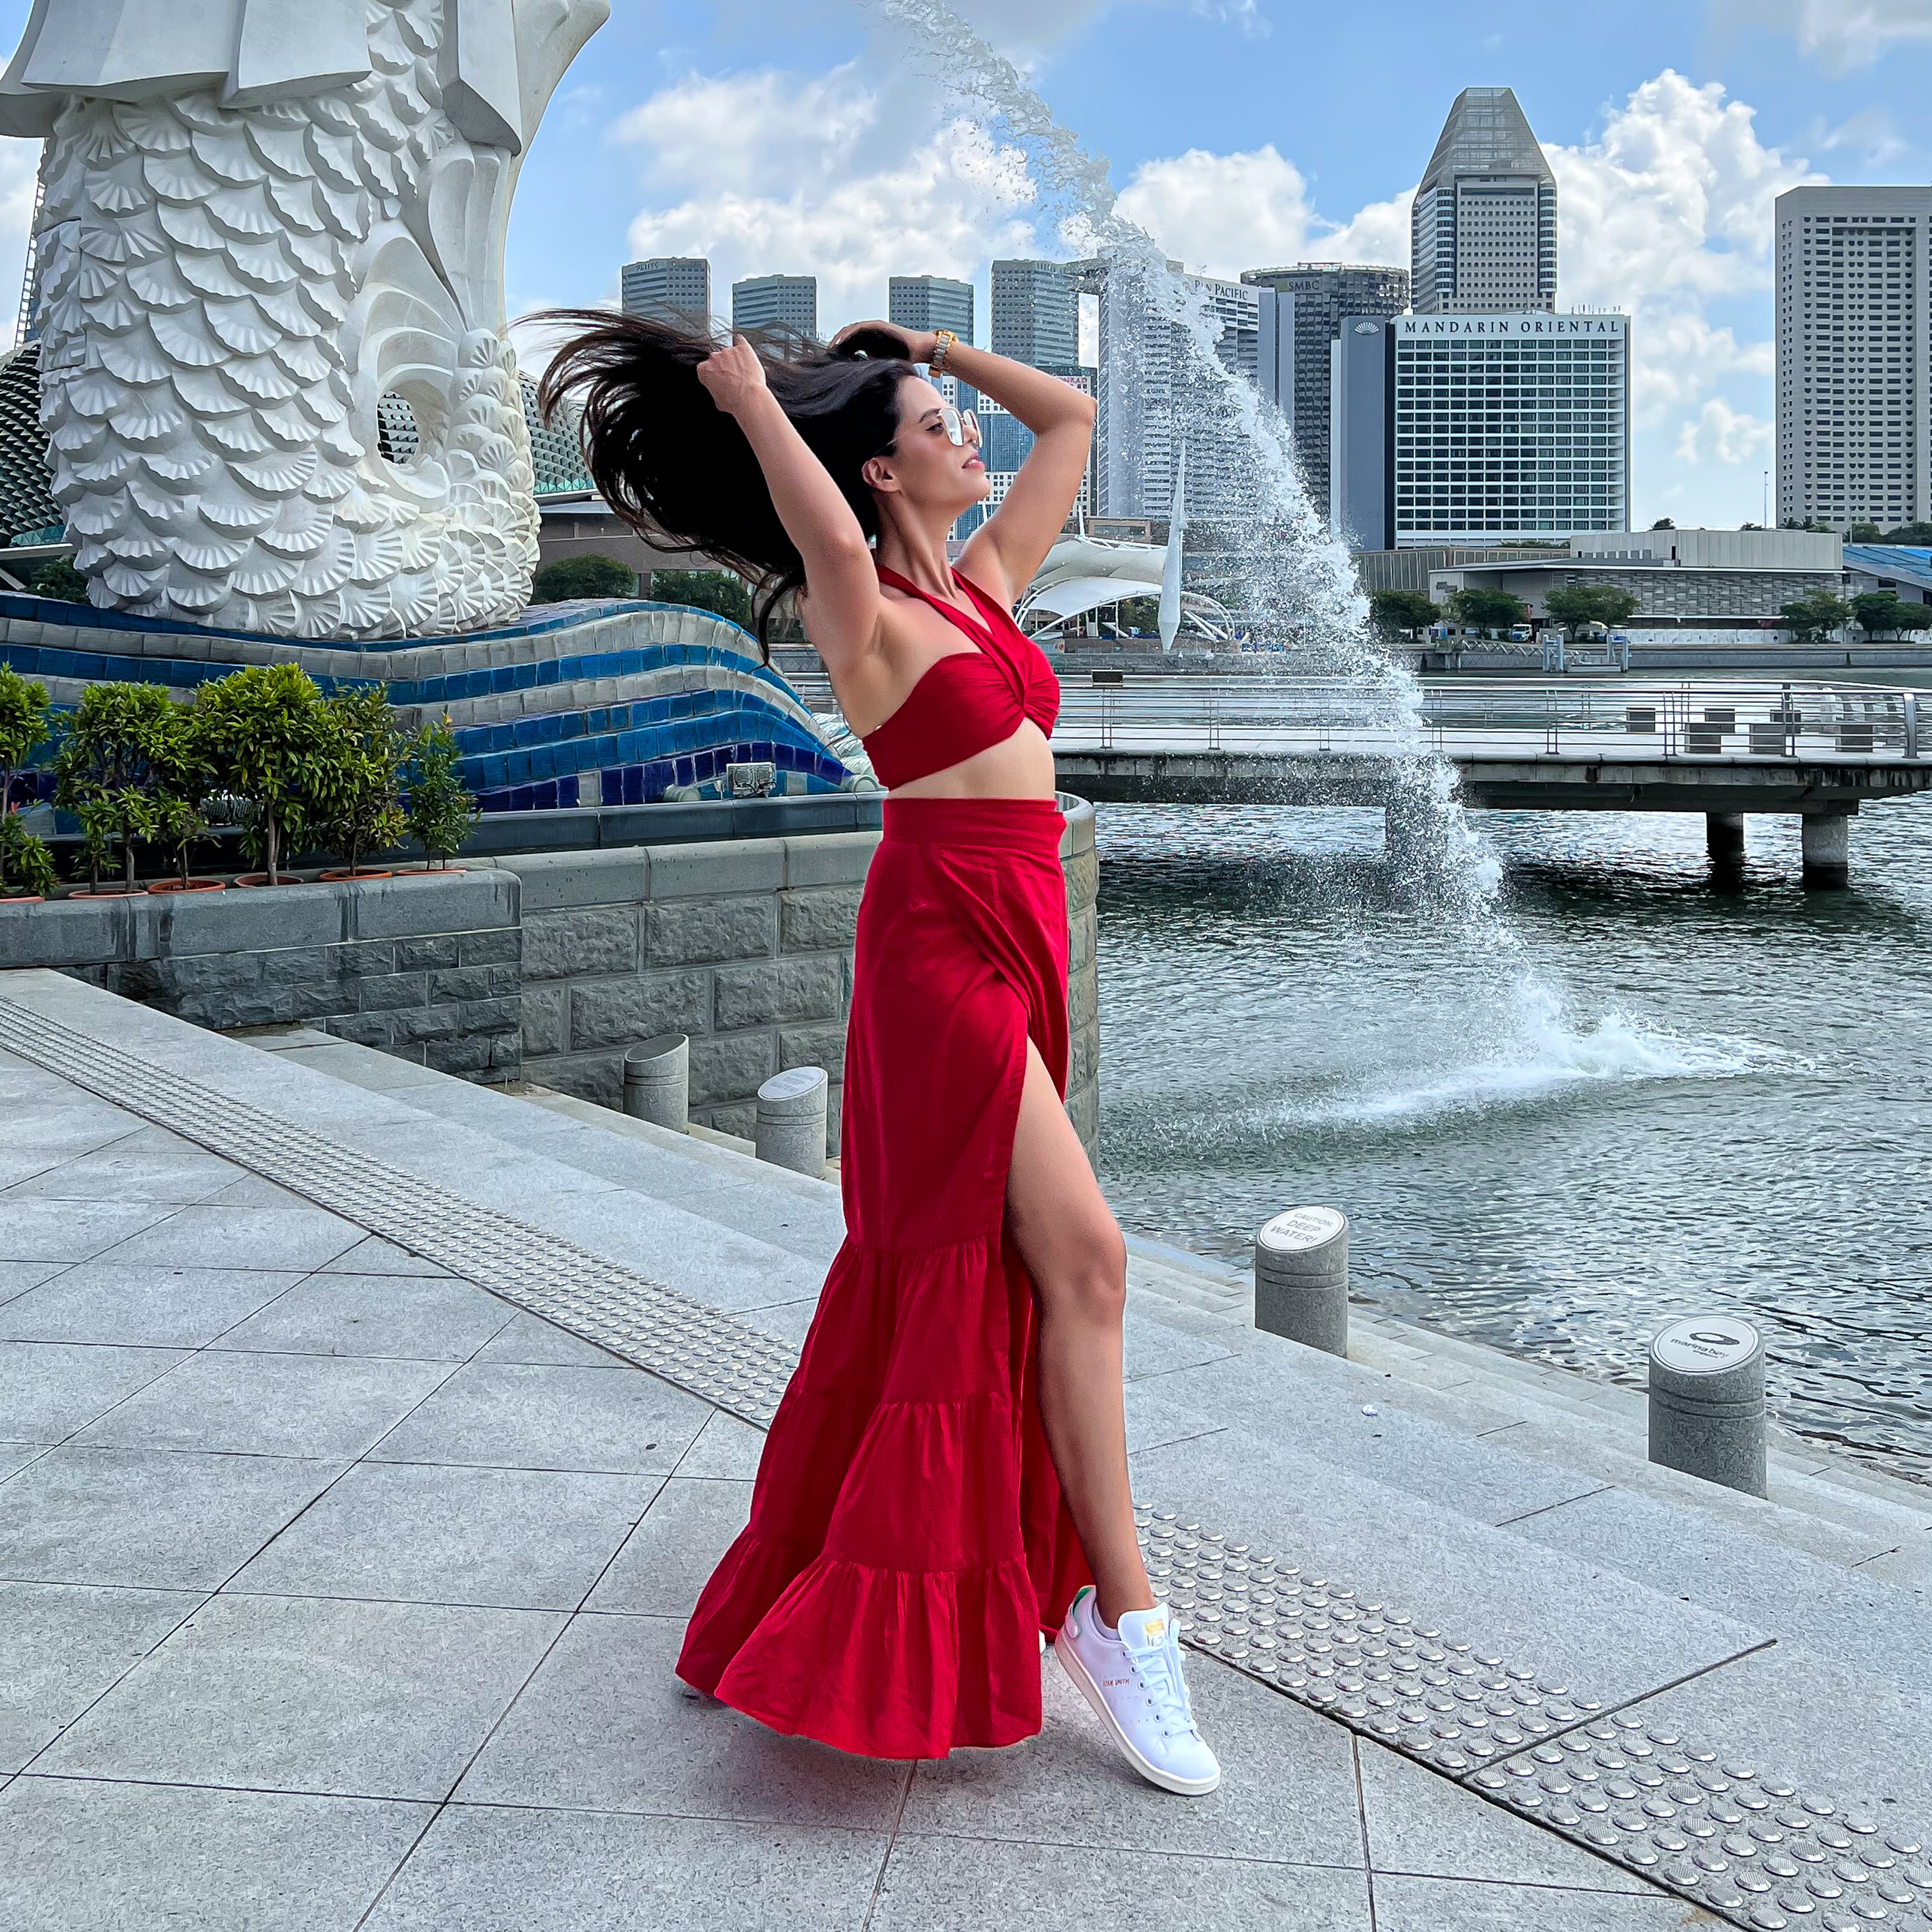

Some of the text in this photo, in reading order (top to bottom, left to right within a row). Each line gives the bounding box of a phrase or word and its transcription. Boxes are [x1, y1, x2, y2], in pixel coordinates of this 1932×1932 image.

[1195, 280, 1248, 300] PN PACIFIC
[1289, 280, 1320, 291] SMBC
[1405, 320, 1618, 333] MANDARIN ORIENTAL
[1286, 1220, 1322, 1232] DEEP
[1270, 1225, 1318, 1243] WATER!
[1670, 1338, 1708, 1352] marina
[1708, 1348, 1730, 1358] bay
